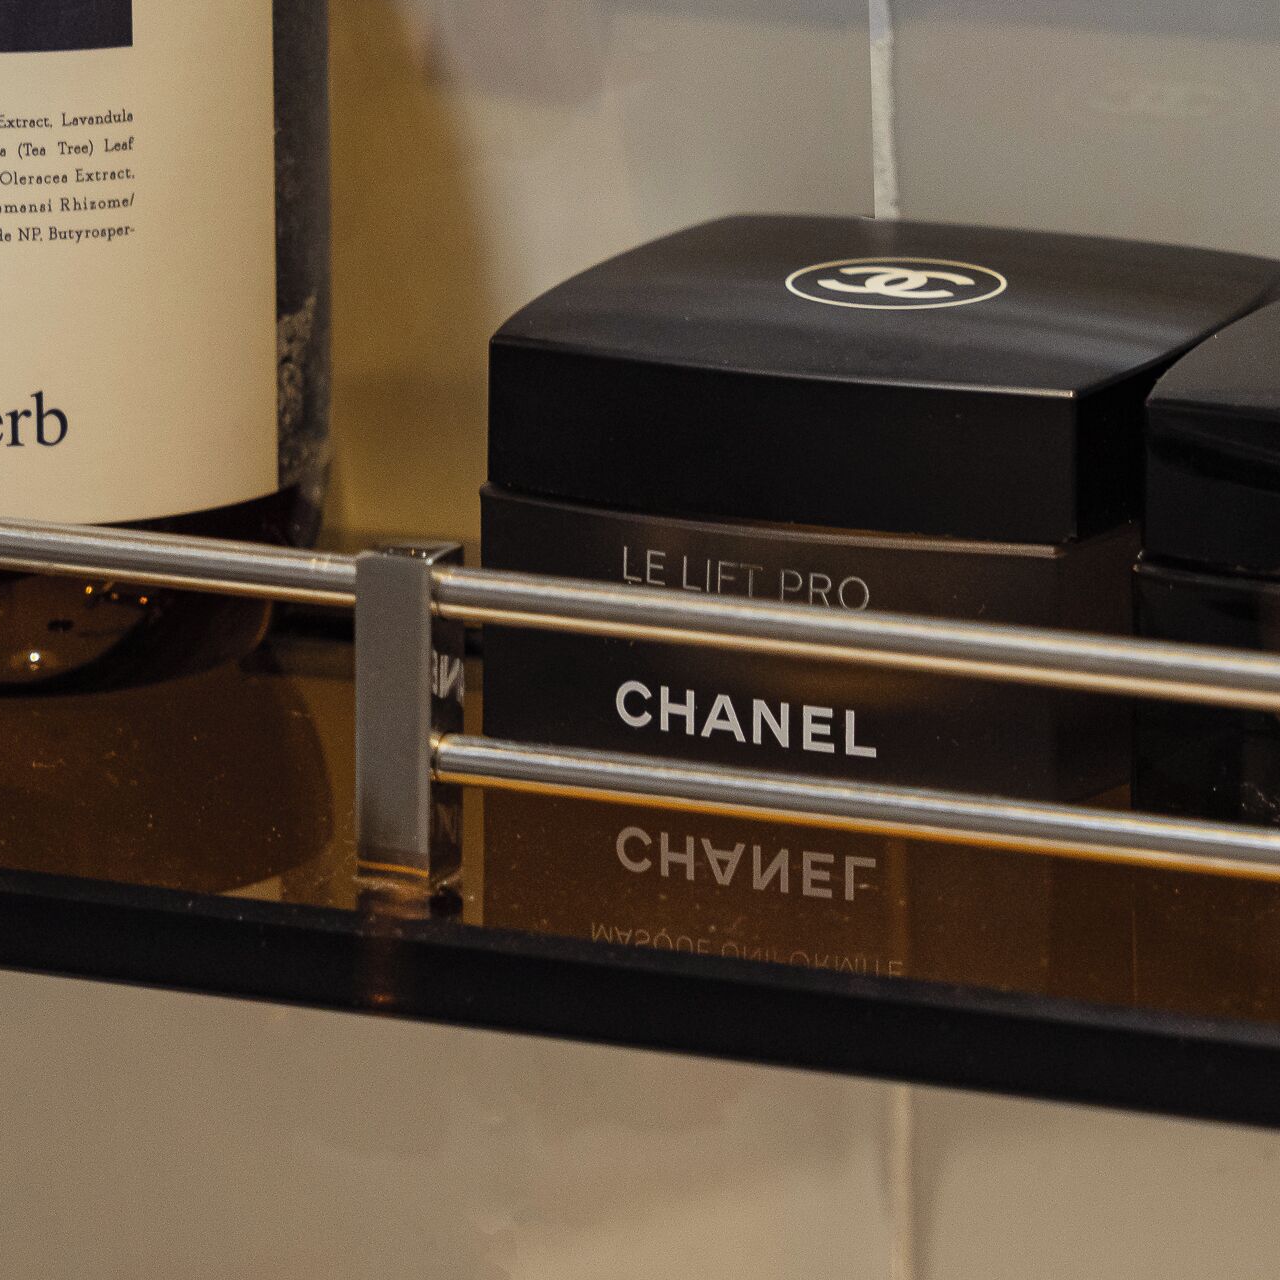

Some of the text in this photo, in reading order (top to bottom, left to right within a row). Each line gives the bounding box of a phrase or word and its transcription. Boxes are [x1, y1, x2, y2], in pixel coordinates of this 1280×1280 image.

[61, 108, 134, 127] Lavandula
[17, 141, 47, 160] (Tea
[57, 139, 95, 157] Tree)
[104, 135, 135, 152] Leaf
[0, 170, 69, 186] Oleracea
[60, 192, 135, 212] Rhizome/
[48, 224, 135, 243] Butyrosper-
[623, 545, 870, 612] LE LIFT PRO
[615, 680, 877, 759] CHANEL
